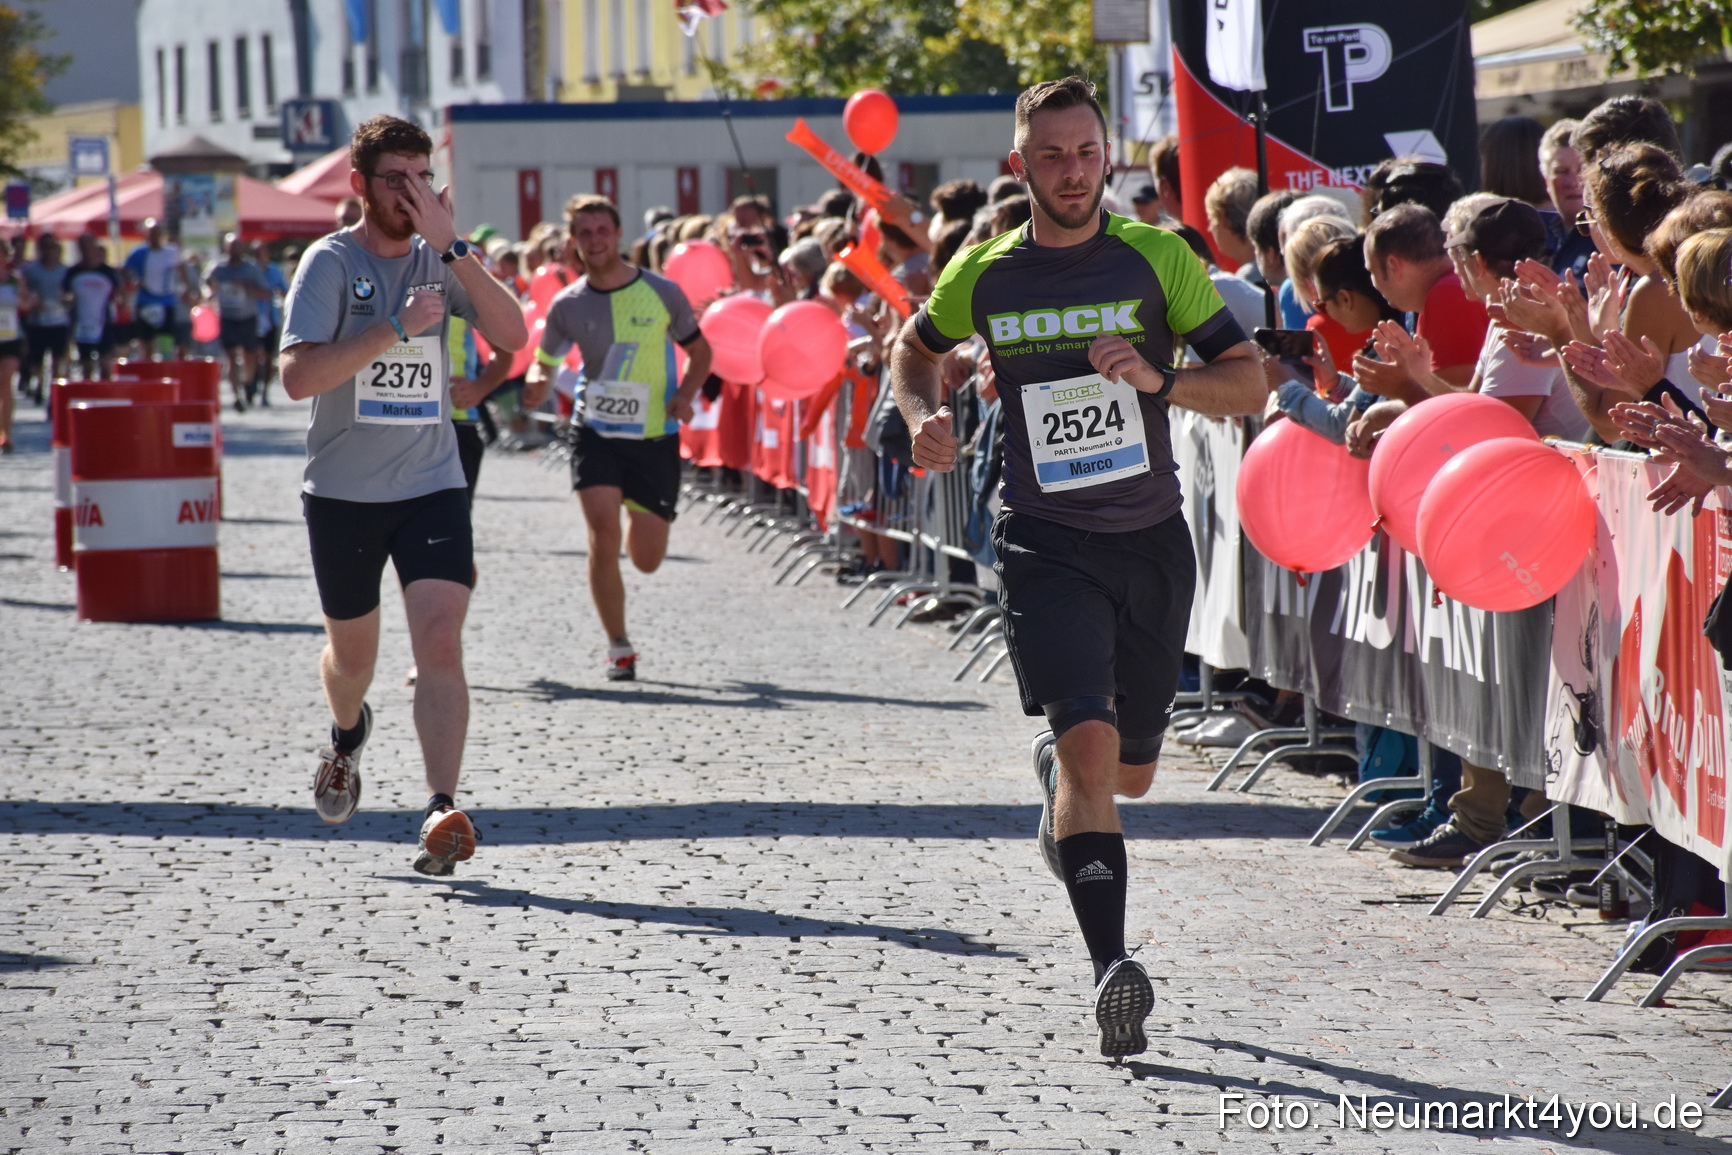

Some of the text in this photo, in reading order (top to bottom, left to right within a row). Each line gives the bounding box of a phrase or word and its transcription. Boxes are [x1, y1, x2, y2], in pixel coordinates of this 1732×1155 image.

[1285, 170, 1324, 189] THE
[987, 299, 1144, 345] BOCK
[385, 345, 424, 356] BOCK
[996, 344, 1033, 358] inspired
[1036, 342, 1051, 353] by
[1055, 340, 1092, 351] smart
[371, 361, 432, 389] 2379
[375, 391, 422, 399] PARTL Neumarkt
[1052, 383, 1103, 402] BOCK
[382, 403, 423, 416] Markus
[595, 396, 639, 415] 2220
[1043, 400, 1125, 446] 2524
[1054, 440, 1113, 457] PARTL Neumarkt
[1069, 457, 1113, 476] Marco
[1075, 868, 1113, 878] adidas
